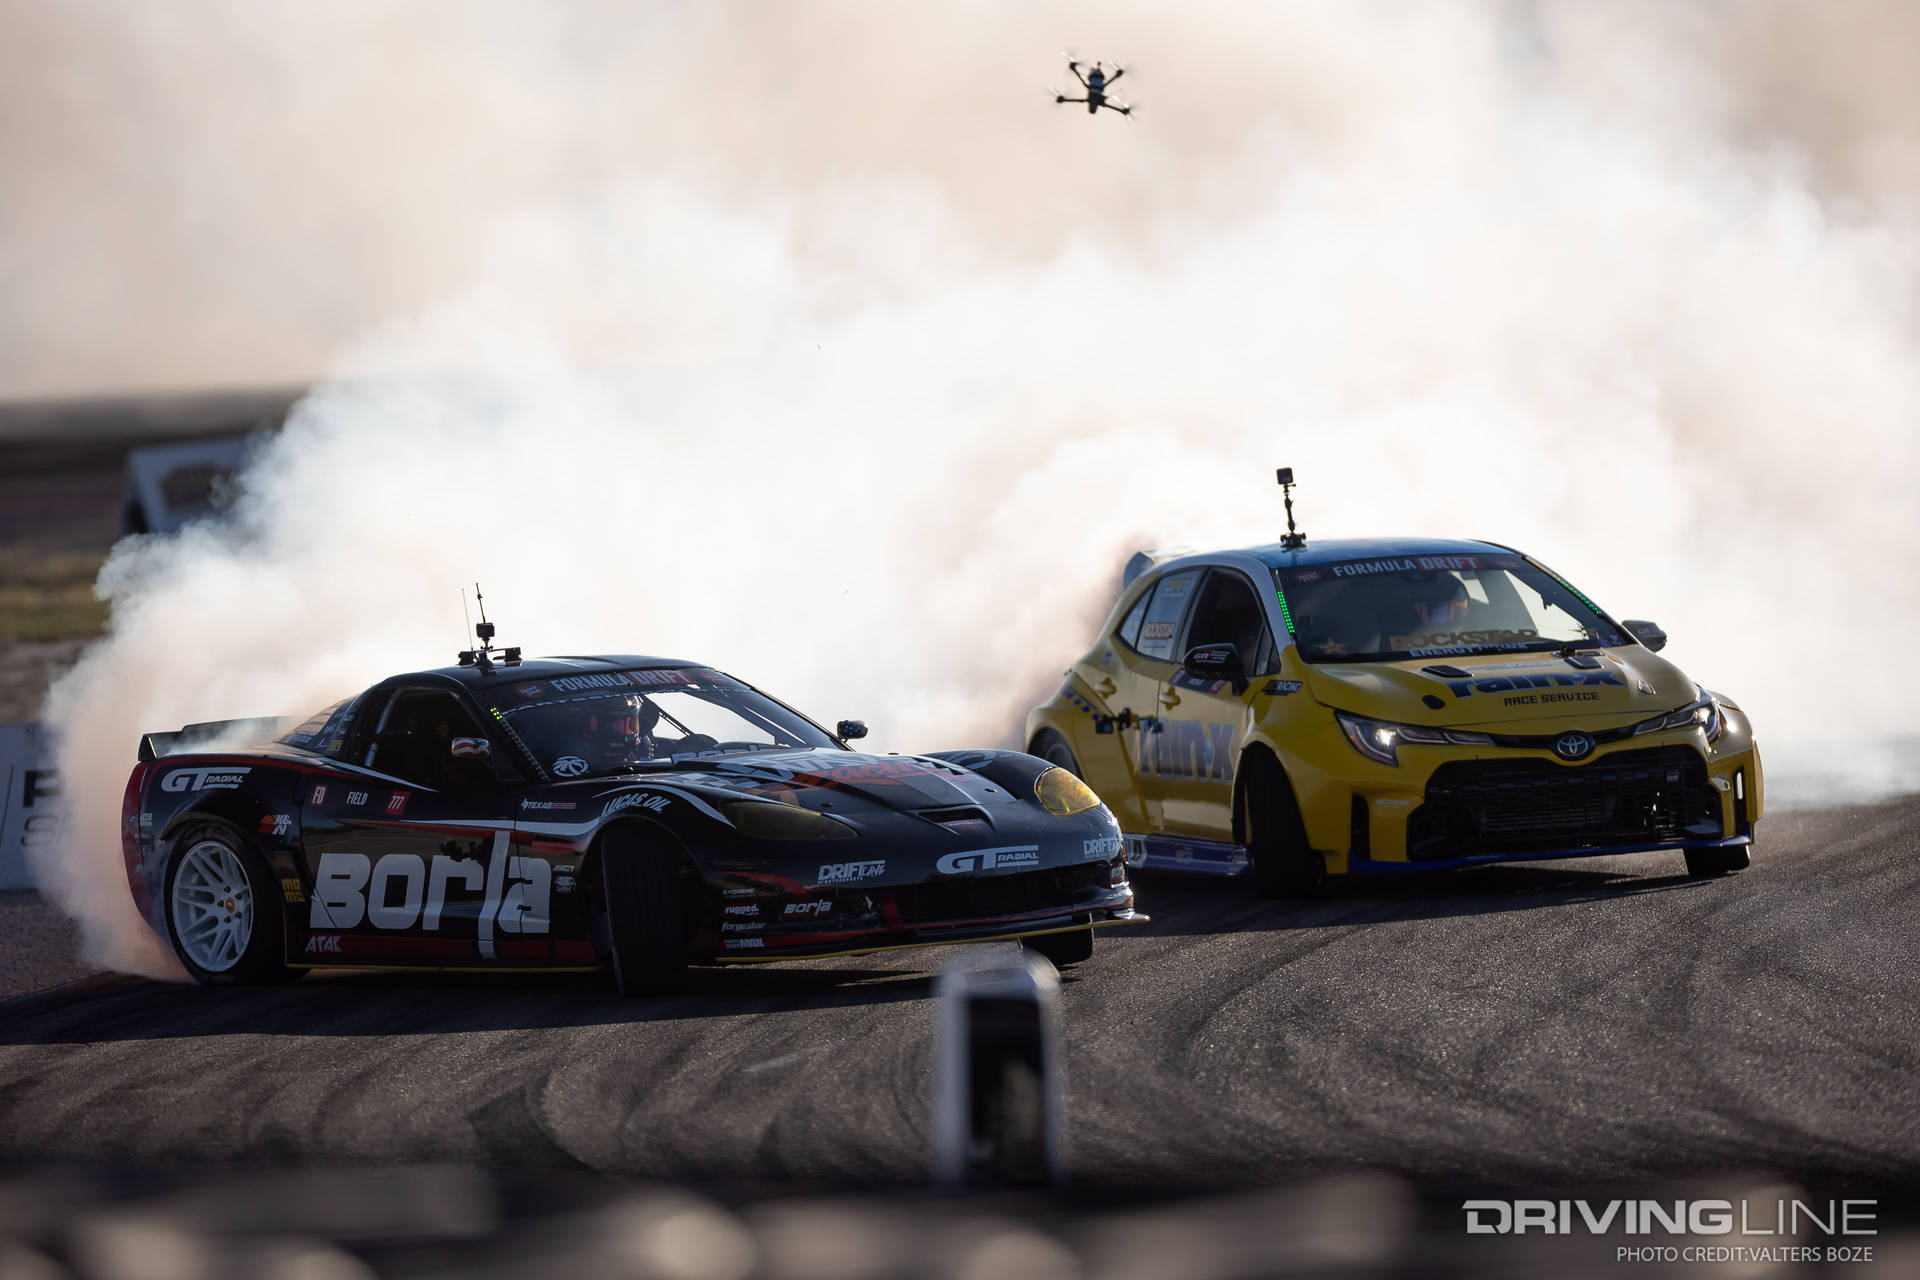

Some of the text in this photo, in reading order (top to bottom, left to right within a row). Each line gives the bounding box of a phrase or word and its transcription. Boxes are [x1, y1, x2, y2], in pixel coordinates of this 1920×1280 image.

[1332, 559, 1417, 577] FORMULA
[1419, 557, 1478, 569] DRIFT
[1409, 645, 1474, 657] ENERGY
[550, 673, 633, 692] FORMULA
[633, 669, 690, 685] DRIFT
[1504, 692, 1600, 707] RACE SERVICE
[205, 775, 243, 788] RADIAL
[311, 785, 326, 805] FD
[346, 791, 368, 805] FIELD
[387, 795, 407, 810] 777
[527, 801, 553, 809] TEXAS
[599, 793, 672, 821] LUCAS OIL
[936, 845, 1039, 874] GT RADIAL
[304, 935, 343, 957] ATAK
